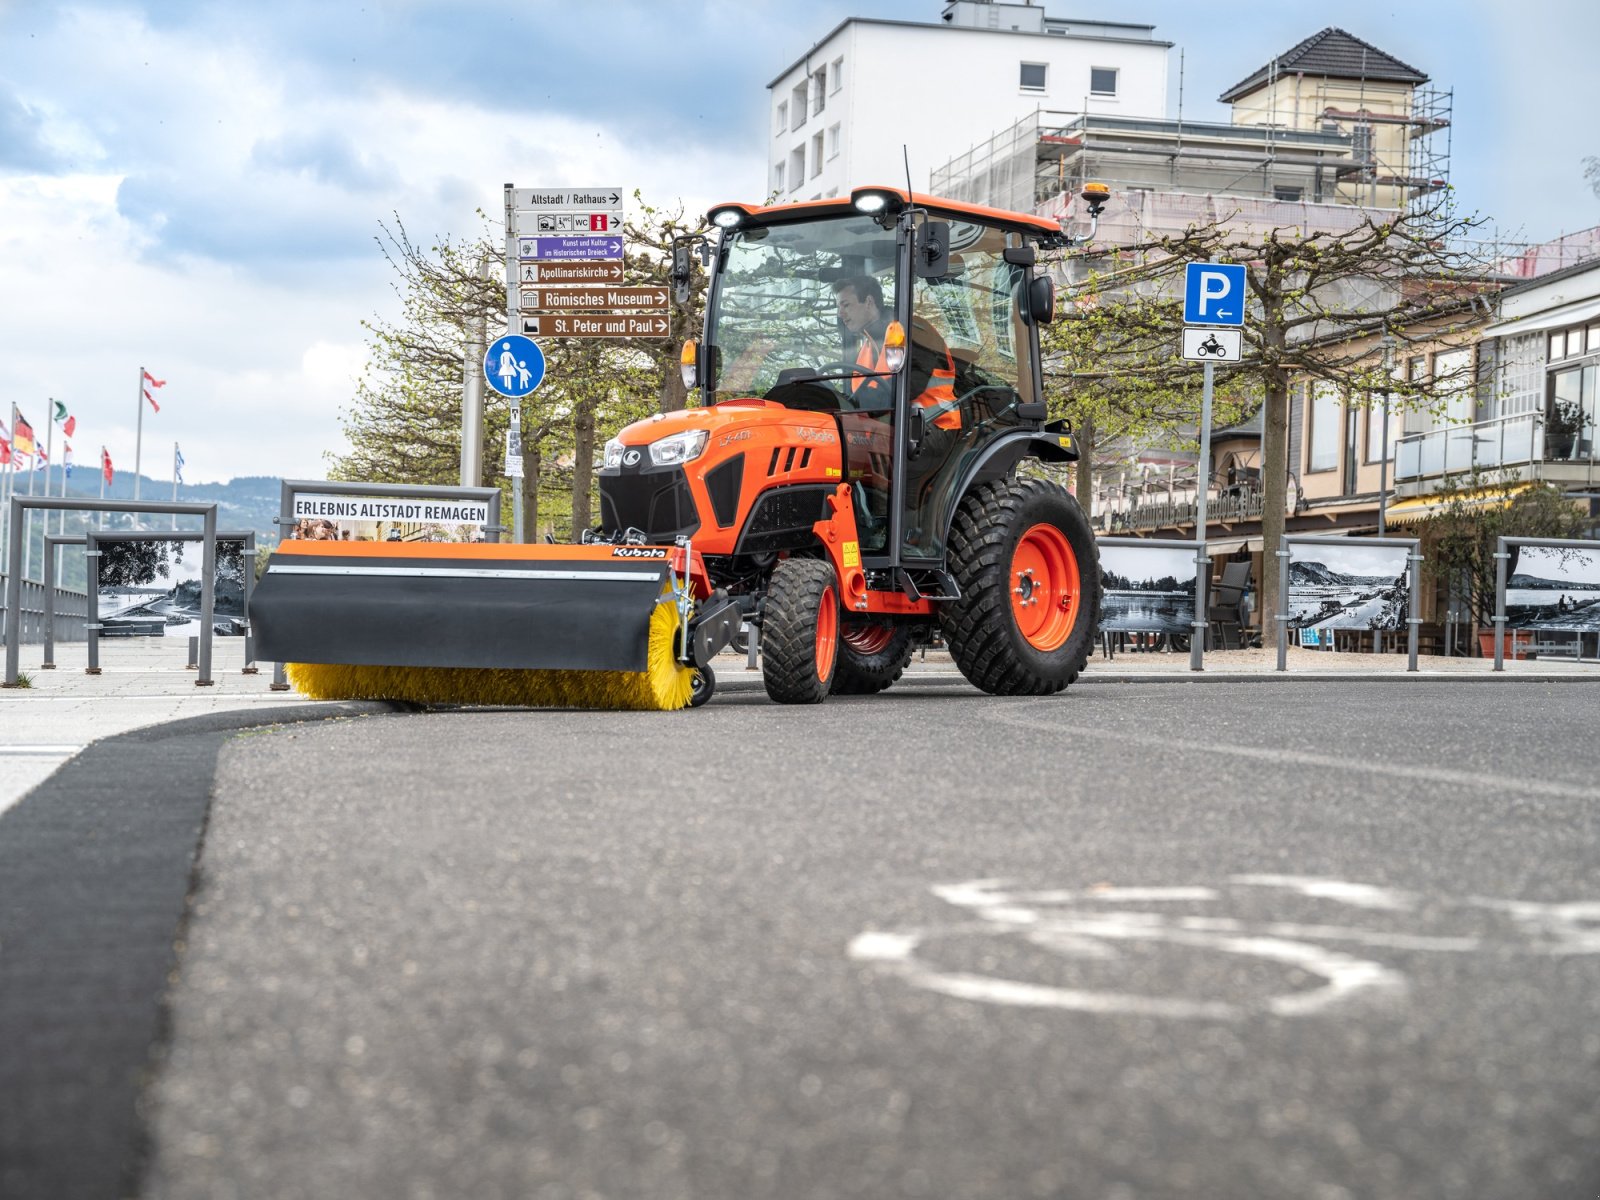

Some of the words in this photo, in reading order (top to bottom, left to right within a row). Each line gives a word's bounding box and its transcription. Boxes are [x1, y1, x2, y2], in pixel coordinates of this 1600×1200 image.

[531, 194, 564, 205] Altstadt
[566, 194, 570, 204] /
[573, 194, 607, 204] Rathaus
[562, 239, 578, 247] Kunst
[591, 239, 608, 247] Kultur
[587, 248, 608, 256] Dreieck
[540, 267, 609, 279] Apollinariskirche
[545, 292, 604, 306] Römisches
[607, 292, 653, 306] Museum
[1198, 271, 1232, 316] P
[555, 319, 570, 333] St.
[573, 319, 603, 333] Peter
[606, 319, 626, 333] und
[629, 319, 653, 333] Paul
[796, 427, 836, 444] Kubota
[296, 501, 357, 517] ERLEBNIS
[360, 503, 422, 519] ALTSTADT
[424, 506, 486, 521] REMAGEN
[613, 547, 666, 558] Kubota
